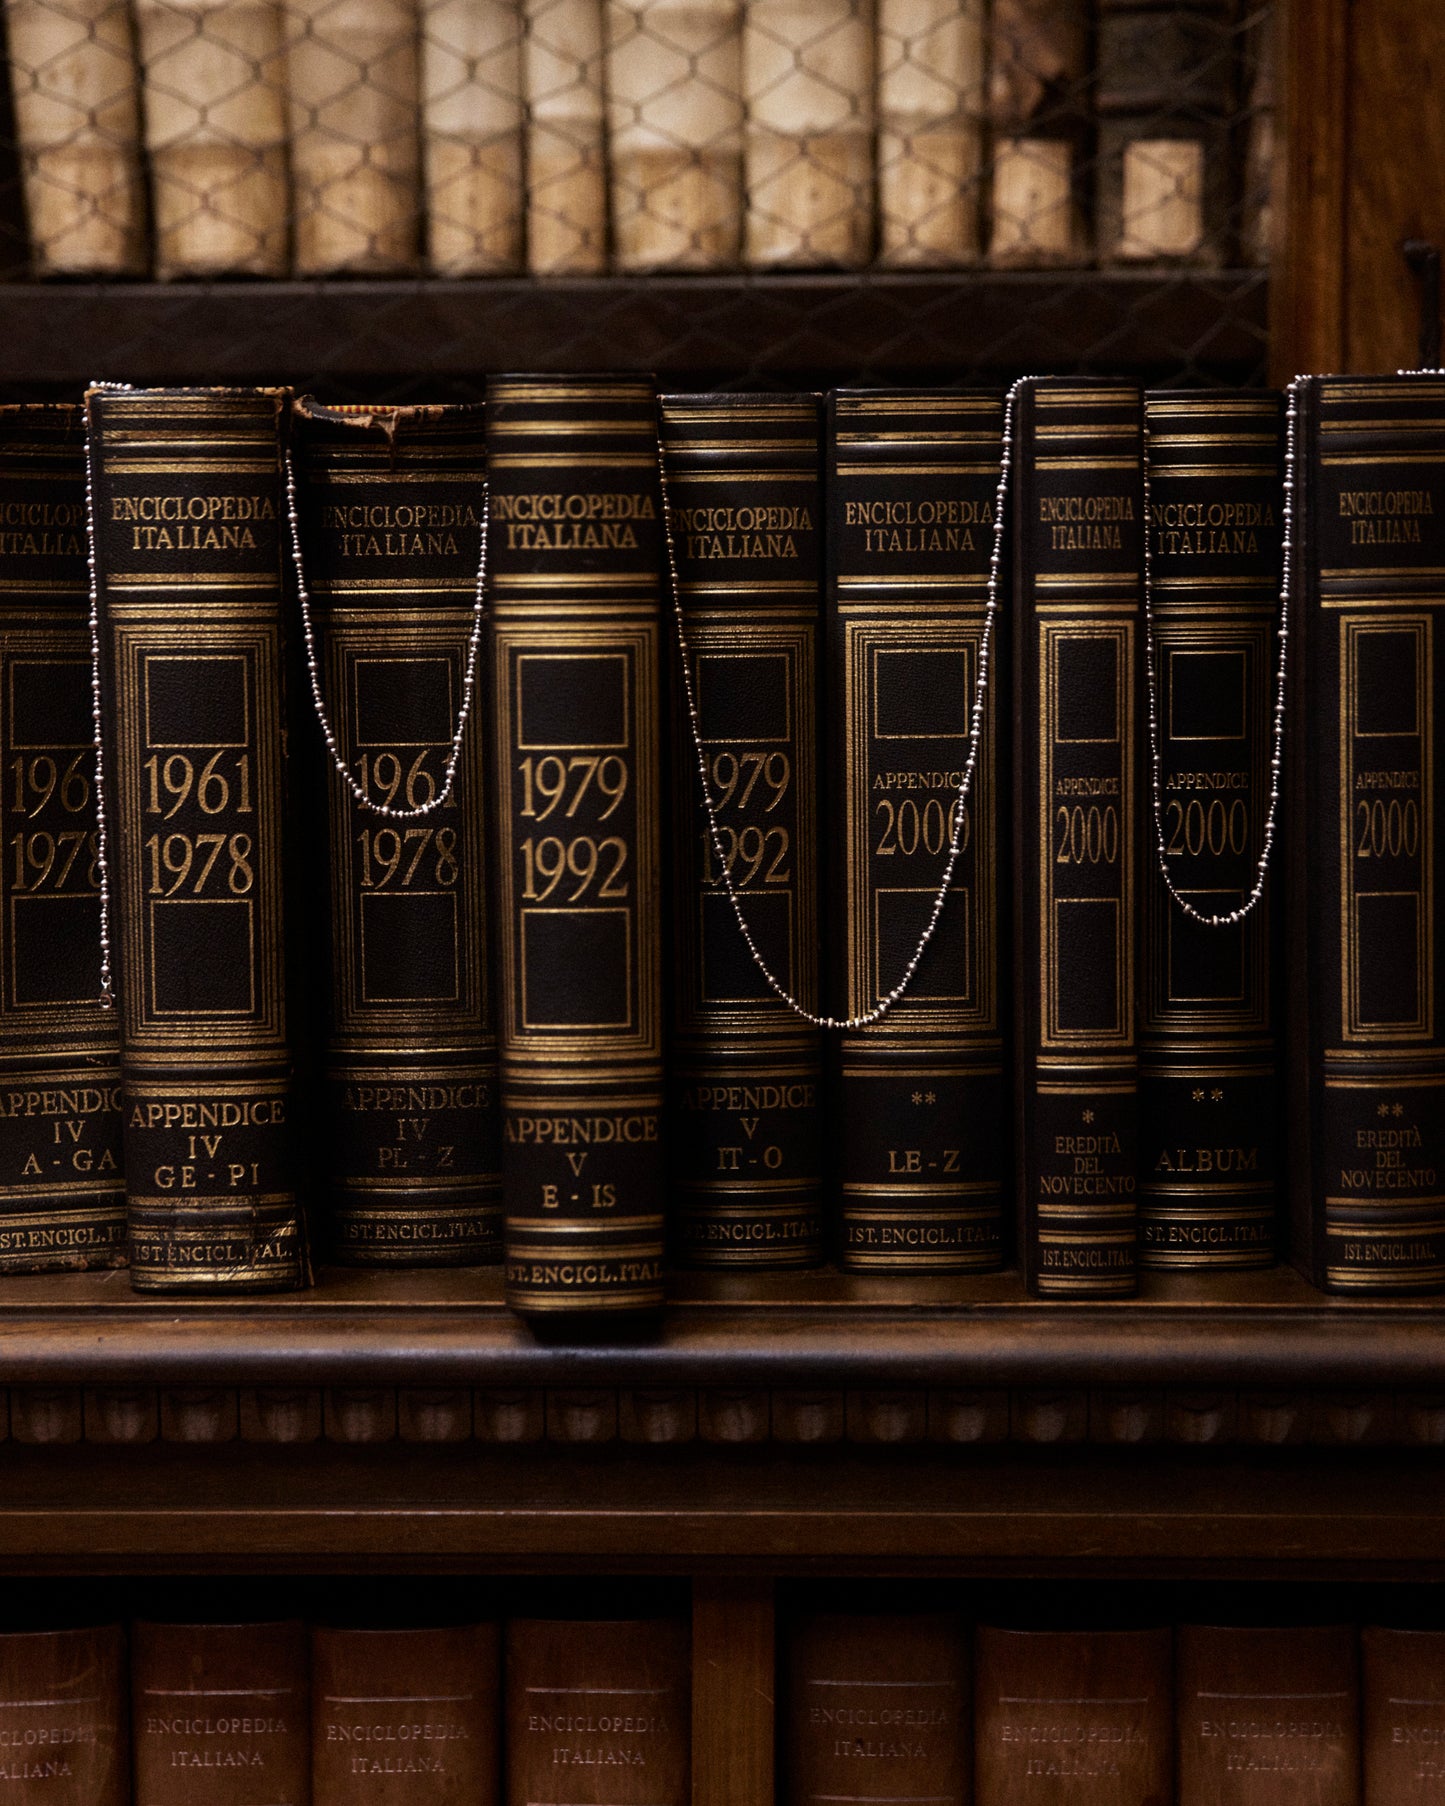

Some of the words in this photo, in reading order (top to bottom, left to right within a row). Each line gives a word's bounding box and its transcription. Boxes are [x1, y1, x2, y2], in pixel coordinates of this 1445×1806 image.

[111, 497, 276, 521] ENCICLOPEDIA
[845, 500, 995, 525] ENCICLOPEDIA
[1040, 496, 1135, 522] ENCICLOPEDIA
[1149, 503, 1276, 528] NCICLOPEDIA
[1339, 491, 1433, 516] ENCICLOPEDIA
[132, 526, 257, 550] ITALIANA
[507, 523, 638, 550] ITALIANA
[865, 528, 975, 552] ITALIANA
[1051, 525, 1122, 551] ITALIANA
[1158, 530, 1258, 555] ITALIANA
[1351, 518, 1422, 544] ITALIANA
[341, 533, 459, 557] ITALIANA
[687, 534, 799, 559] ITALIANA
[143, 750, 253, 820] 1961
[518, 755, 628, 822] 1979
[873, 771, 967, 790] APPENDIC
[1056, 777, 1120, 796] APPENDICE
[1166, 772, 1248, 790] APPENDICE
[1355, 771, 1419, 790] APPENDICE
[876, 799, 970, 855] 2000
[1056, 805, 1118, 864] 2000
[1166, 799, 1248, 856] 2000
[1357, 799, 1418, 858] 2000
[145, 832, 254, 897] 1978
[356, 827, 459, 890] 1978
[700, 826, 790, 886] 1992
[519, 836, 629, 901] 1992
[344, 1085, 489, 1111] APPENDICE
[129, 1100, 286, 1128] APPENDICE
[53, 1120, 86, 1143] IV
[397, 1118, 430, 1140] IV
[503, 1115, 657, 1144] APPENDICE
[739, 1117, 760, 1140] V
[1356, 1124, 1423, 1148] EREDITÀ
[188, 1135, 222, 1160] IV
[1056, 1131, 1121, 1154] EREDITÀ
[565, 1152, 587, 1178] V
[1074, 1157, 1104, 1175] DEL
[1154, 1150, 1260, 1172] ALBUM
[1376, 1150, 1406, 1168] DEL
[1040, 1175, 1136, 1195] NOVECENTO
[1341, 1168, 1437, 1189] NOVECENTO
[147, 1718, 288, 1734] ENCICLOPEDIA
[528, 1716, 669, 1733] ENCICLOPEDIA
[810, 1707, 949, 1725] ENCICLOPEDIA
[327, 1724, 469, 1741] ENCICLOPEDIA
[171, 1751, 264, 1767] ITALIANA
[552, 1748, 645, 1764] ITALIANA
[834, 1740, 927, 1757] ITALIANA
[351, 1757, 446, 1773] ITALIANA
